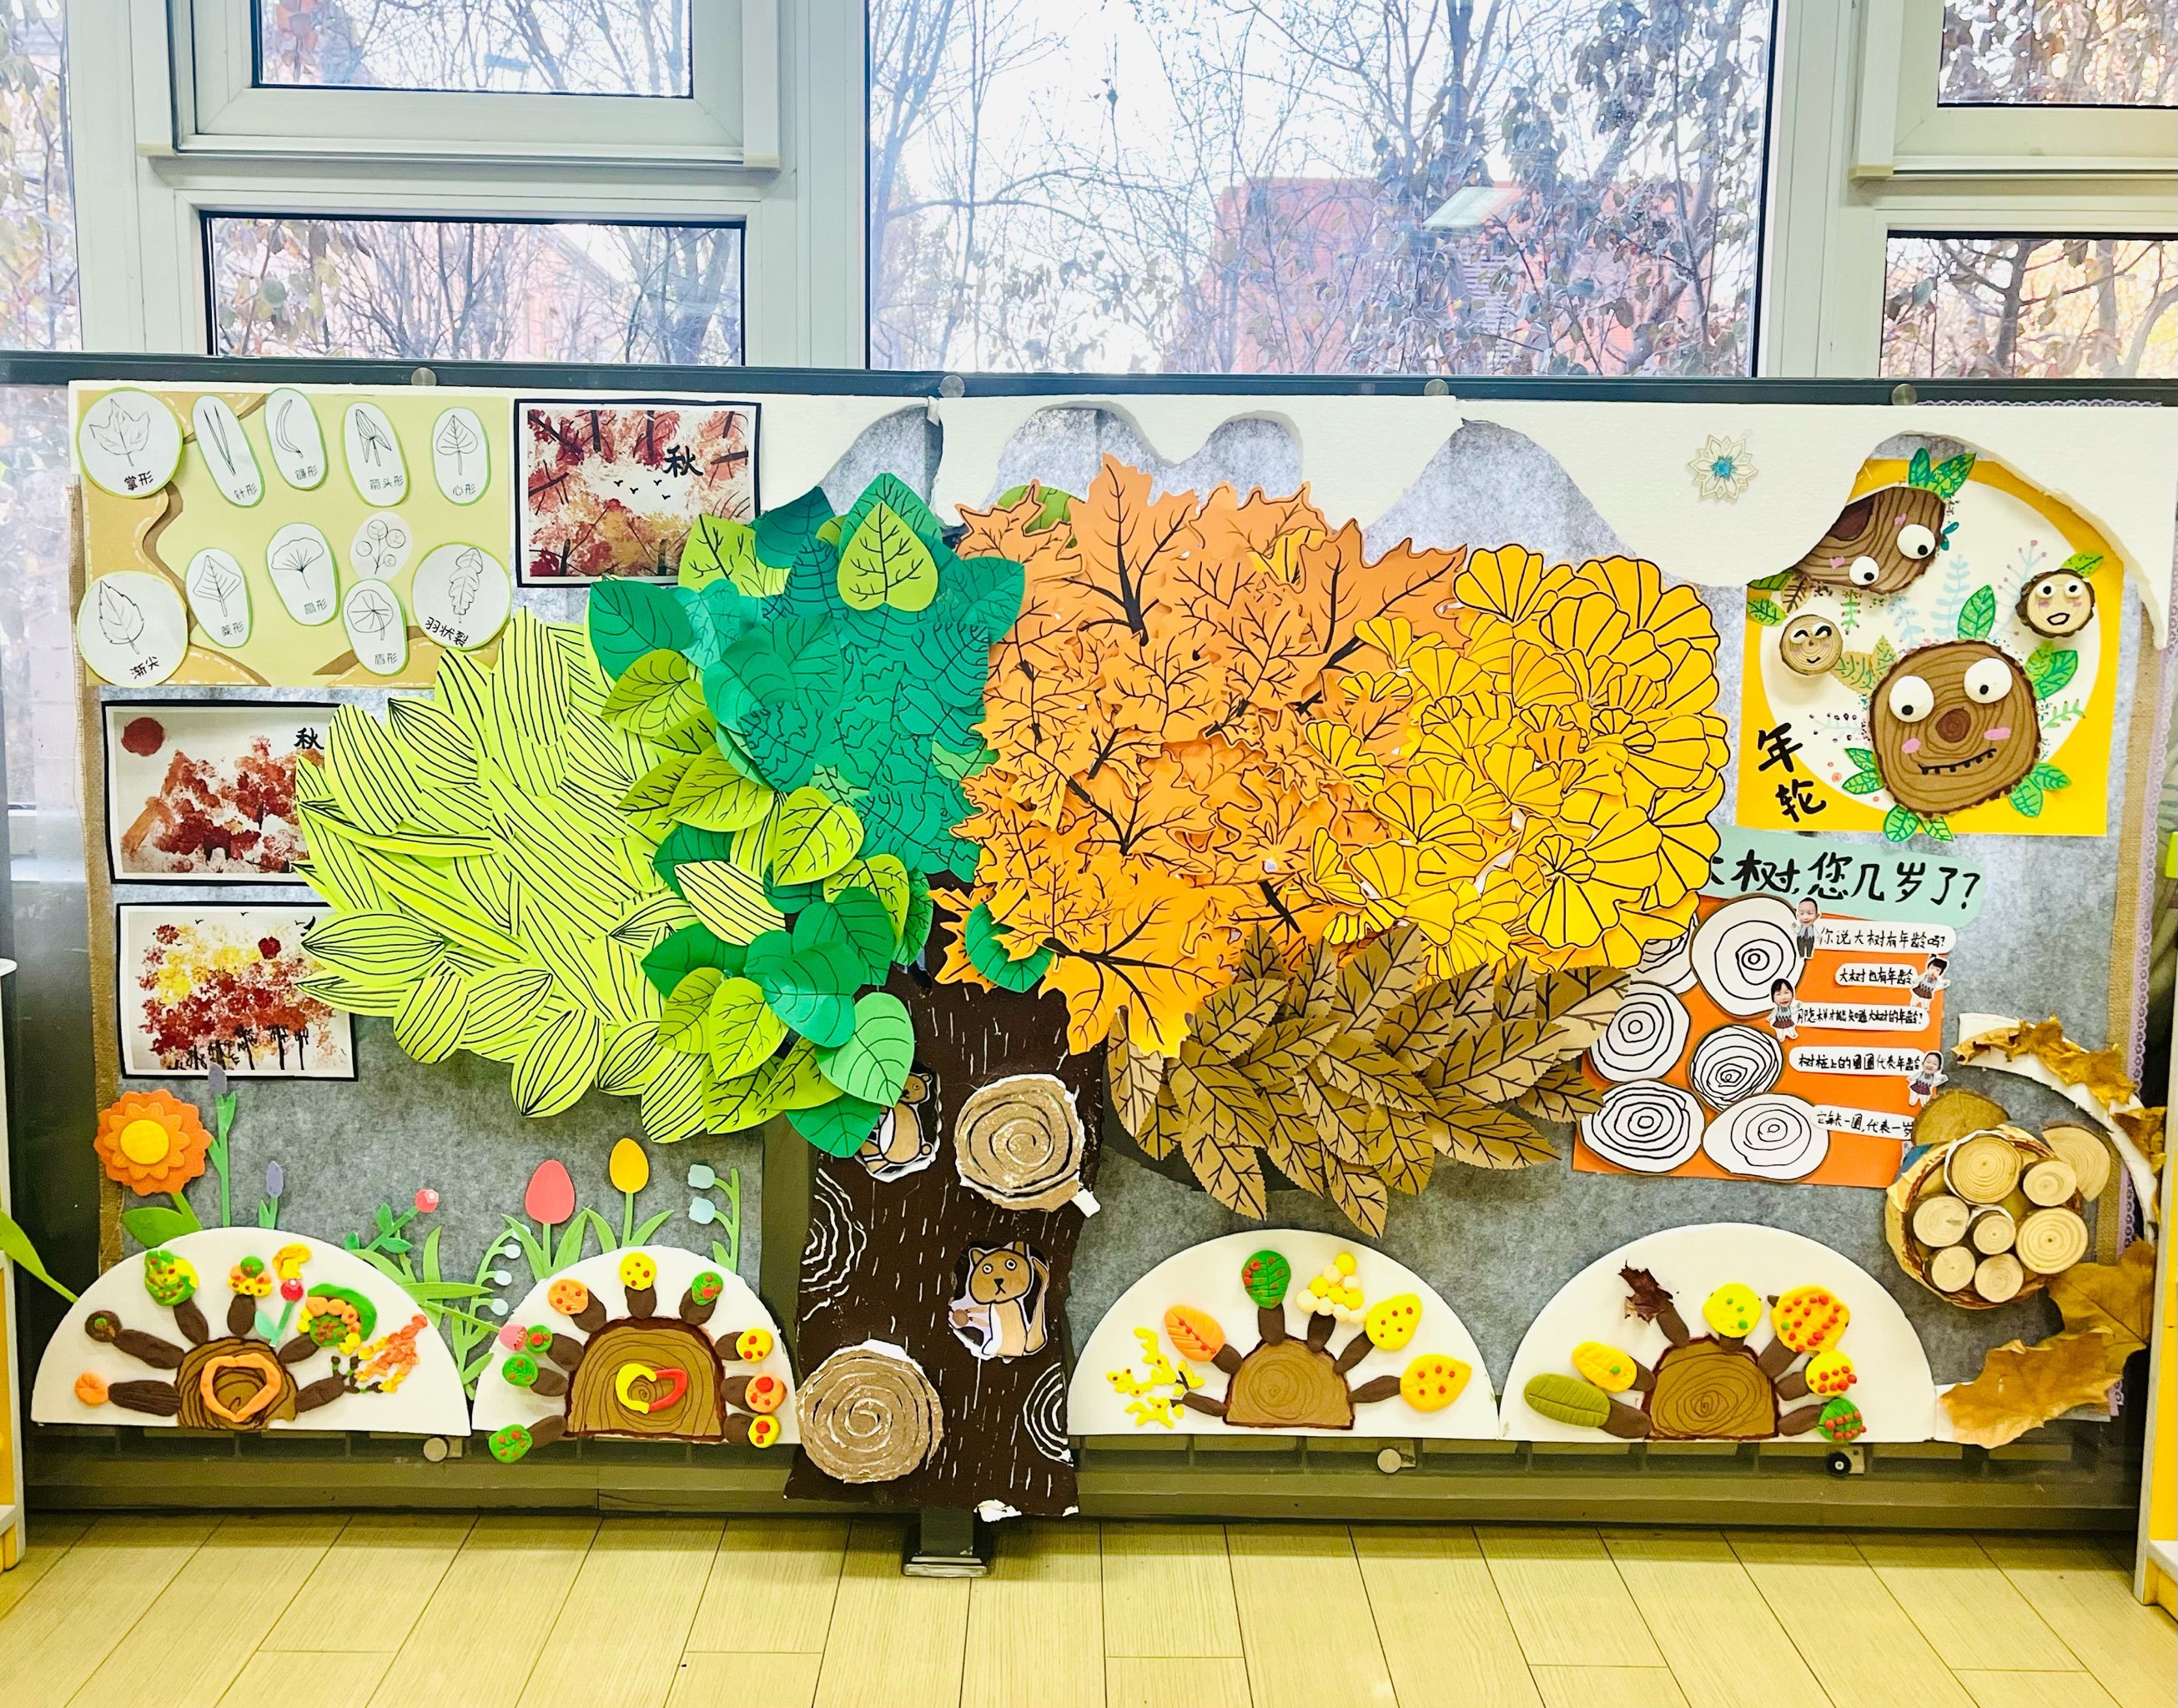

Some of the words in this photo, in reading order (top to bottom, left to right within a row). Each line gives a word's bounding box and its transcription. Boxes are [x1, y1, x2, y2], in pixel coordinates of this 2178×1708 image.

[662, 445, 703, 477] 秋
[124, 470, 154, 490] 掌形
[369, 475, 405, 490] 箭头形
[452, 483, 476, 496] 心形
[234, 483, 258, 500] 针形
[425, 616, 469, 647] 羽状裂
[129, 656, 159, 680] 渐尖
[375, 652, 398, 666] 盾形
[294, 727, 324, 750] 秋
